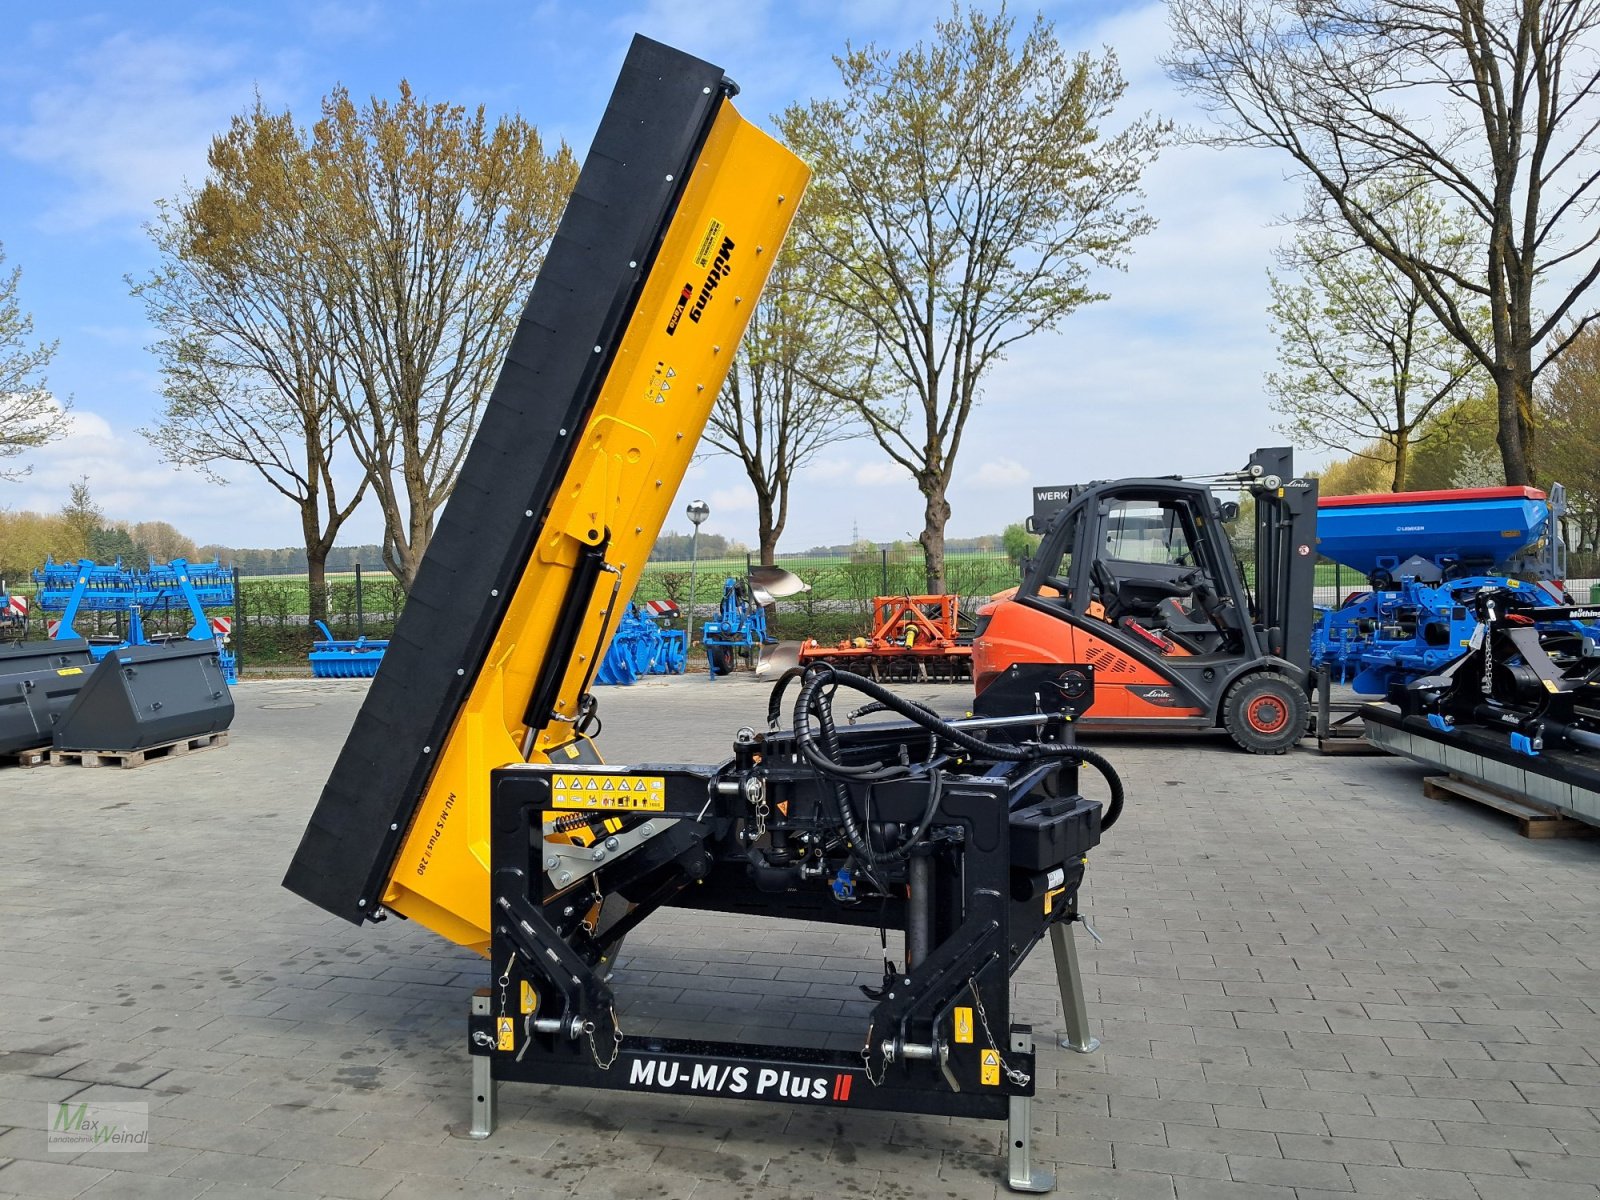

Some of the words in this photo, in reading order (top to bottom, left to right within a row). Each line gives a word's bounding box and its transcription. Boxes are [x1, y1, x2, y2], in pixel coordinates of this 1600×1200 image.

[689, 236, 735, 324] Müthing
[669, 304, 685, 329] Vario
[1283, 479, 1310, 488] Linde
[1037, 491, 1069, 501] WERK
[1143, 689, 1170, 698] Linde
[436, 792, 457, 829] MU-M/S
[426, 828, 441, 851] Plus
[417, 857, 429, 876] 280
[629, 1058, 750, 1093] MU-M/S
[756, 1068, 828, 1099] Plus
